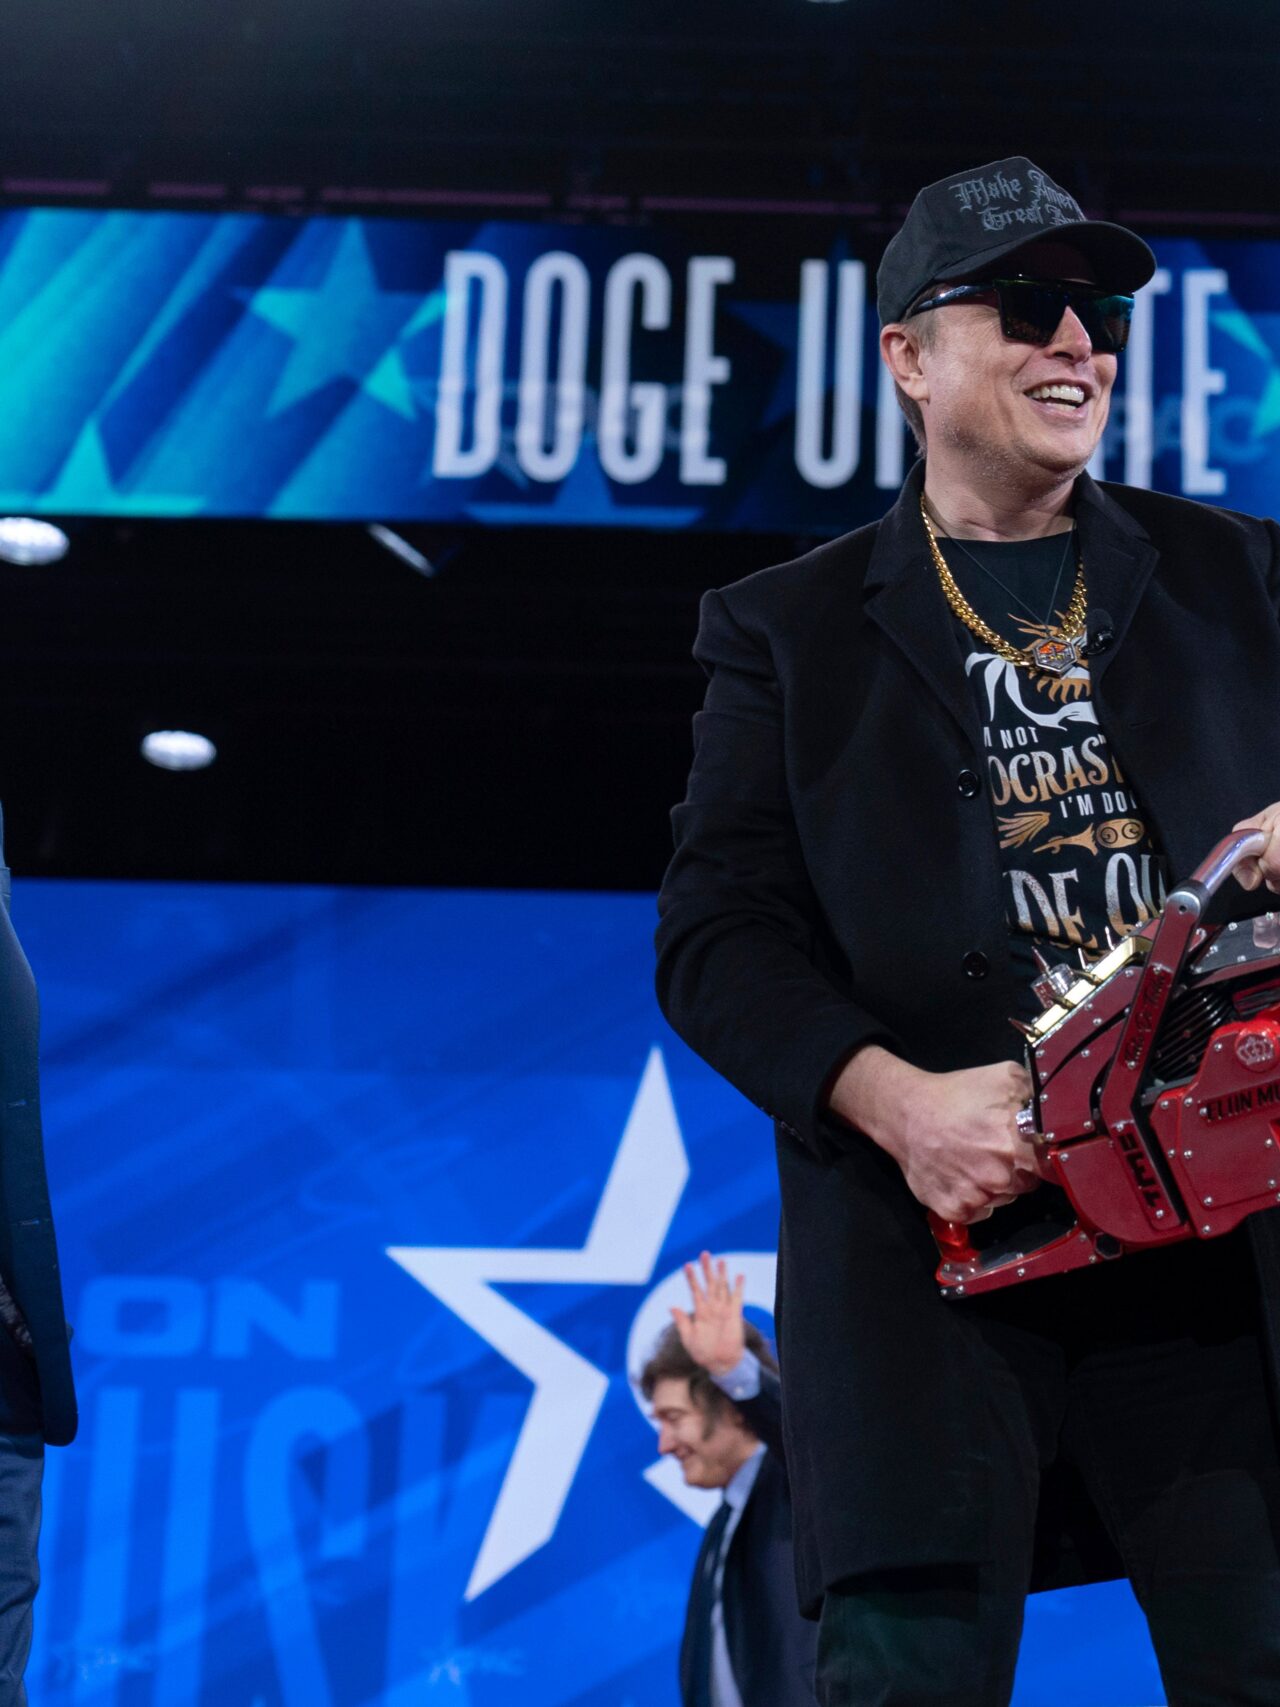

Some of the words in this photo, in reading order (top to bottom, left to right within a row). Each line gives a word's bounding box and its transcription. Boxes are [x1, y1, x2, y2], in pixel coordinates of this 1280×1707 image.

[949, 171, 1023, 212] Make
[1027, 169, 1087, 222] Amer
[976, 199, 1043, 231] Great
[432, 250, 735, 486] DOGE
[1000, 726, 1039, 749] NOT
[1060, 794, 1094, 818] I'M
